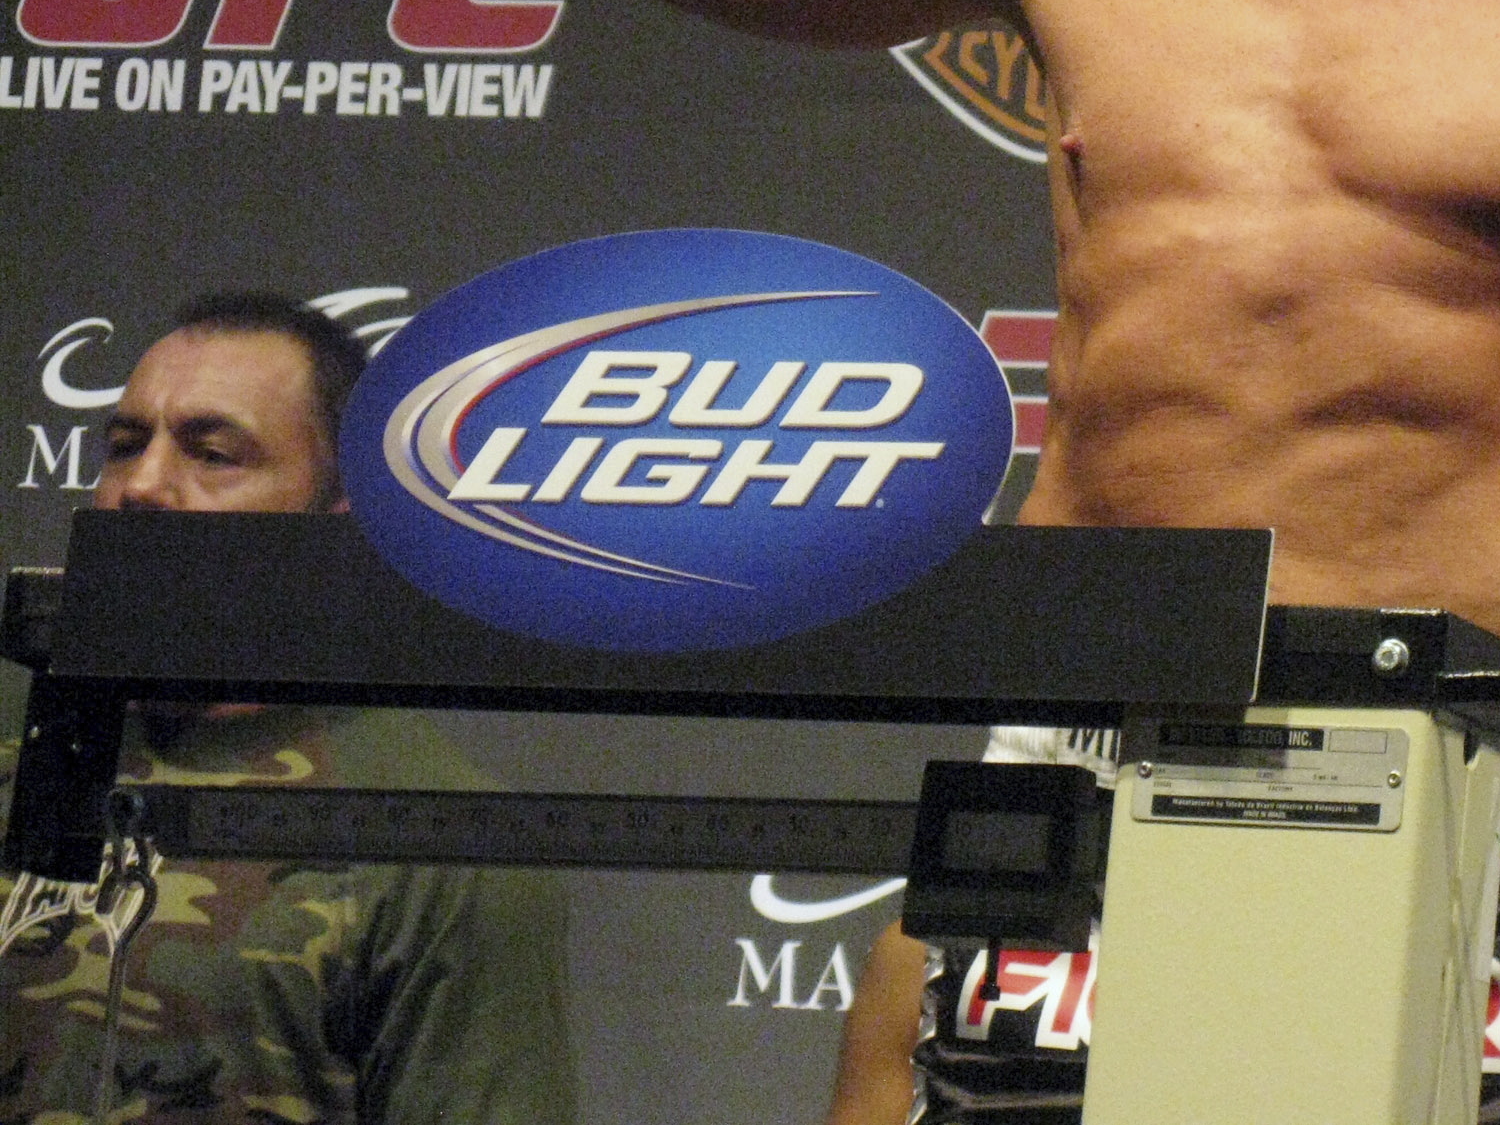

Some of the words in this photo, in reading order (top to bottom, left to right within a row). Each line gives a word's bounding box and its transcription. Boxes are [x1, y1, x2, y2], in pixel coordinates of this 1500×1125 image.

[0, 56, 102, 110] LIVE
[115, 58, 186, 112] ON
[199, 60, 553, 119] PAY-PER-VIEW
[541, 351, 924, 428] BUD
[447, 427, 945, 508] LIGHT
